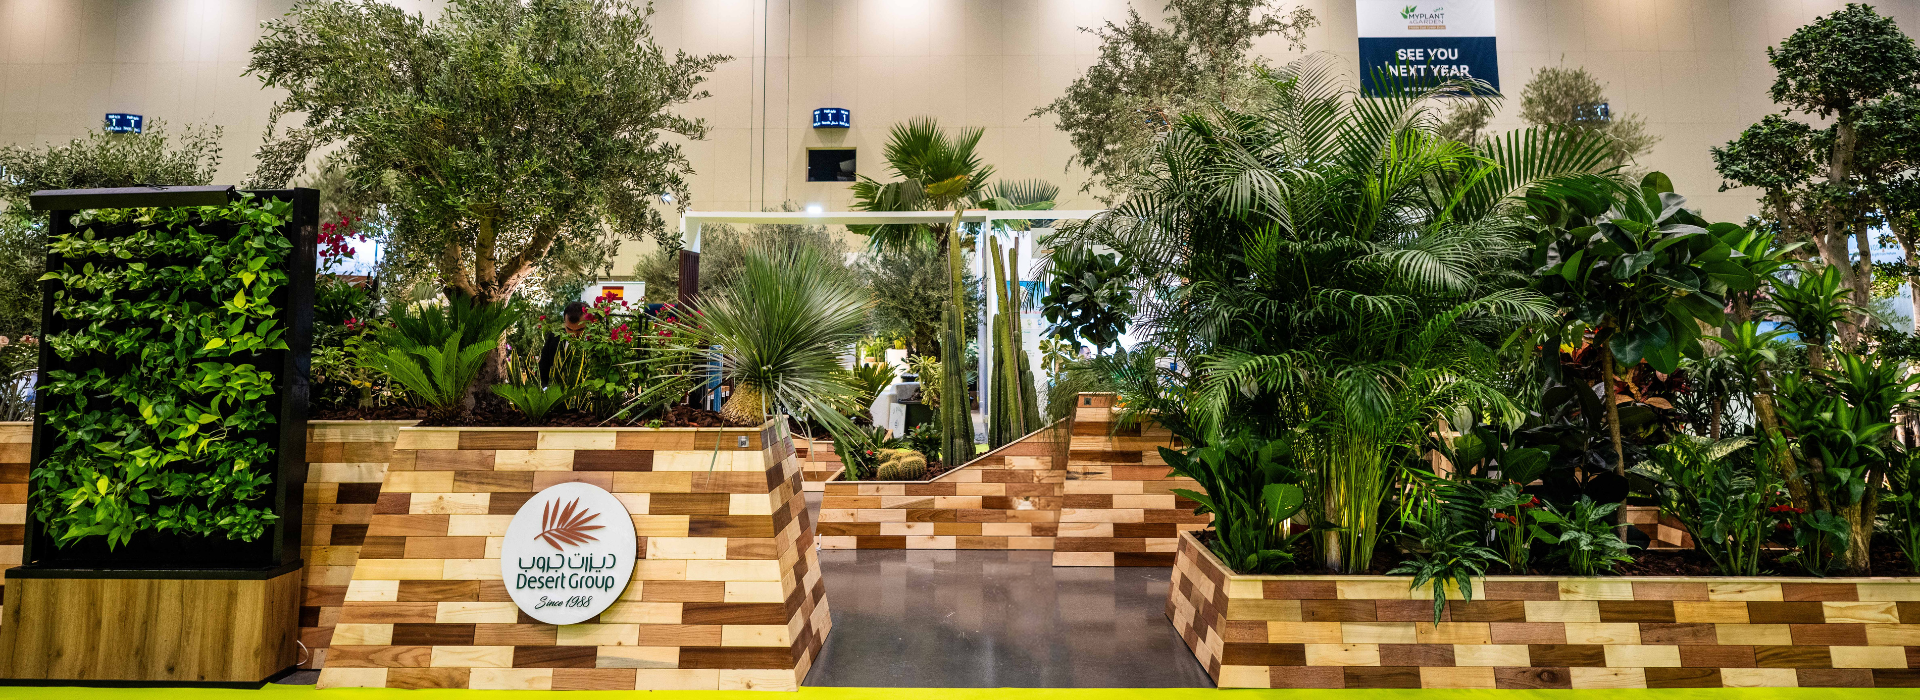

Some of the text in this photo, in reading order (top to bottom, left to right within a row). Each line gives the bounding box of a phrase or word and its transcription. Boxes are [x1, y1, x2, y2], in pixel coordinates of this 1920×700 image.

[1398, 48, 1458, 60] SEE YOU
[1389, 65, 1469, 77] NEXT YEAR
[518, 553, 616, 573] ديزرت جروب
[516, 572, 615, 592] Desert Group
[535, 595, 593, 609] Since 1988
